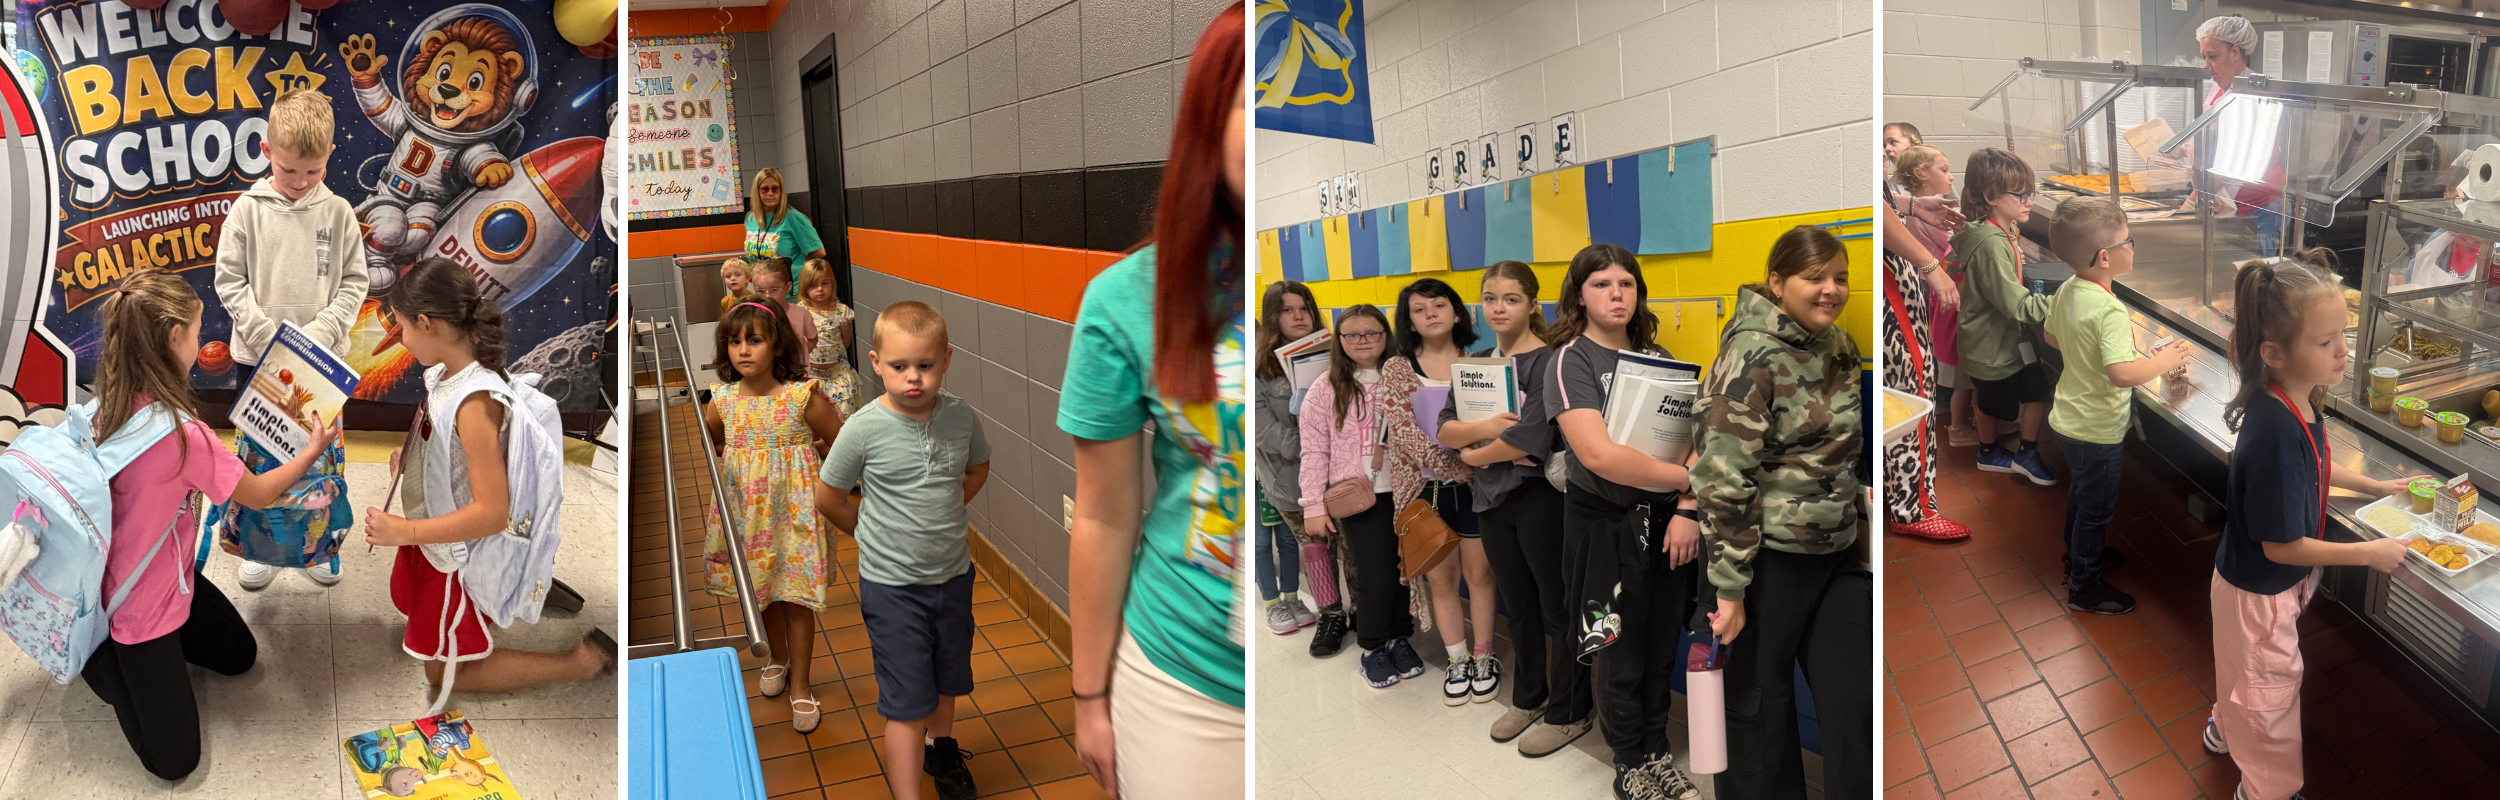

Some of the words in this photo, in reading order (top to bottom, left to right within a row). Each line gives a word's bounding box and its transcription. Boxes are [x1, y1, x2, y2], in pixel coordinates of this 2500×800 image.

[638, 51, 662, 69] BE
[64, 46, 266, 136] BACK
[635, 76, 675, 97] THE
[628, 99, 714, 124] EASON
[66, 117, 271, 204] SCHOO
[400, 136, 436, 178] D
[1428, 122, 1570, 179] GRADE
[644, 180, 693, 202] today
[101, 206, 190, 240] LAUNCHING
[194, 199, 232, 218] INTO
[74, 223, 214, 290] GALACTIC
[438, 235, 511, 300] DEWITT
[280, 332, 334, 375] COMPREHENSION
[283, 326, 314, 350] READING
[344, 376, 351, 385] 1
[1460, 370, 1484, 381] Simple
[248, 396, 289, 433] Simple
[1662, 394, 1694, 409] Simple
[2458, 514, 2475, 530] MILK
